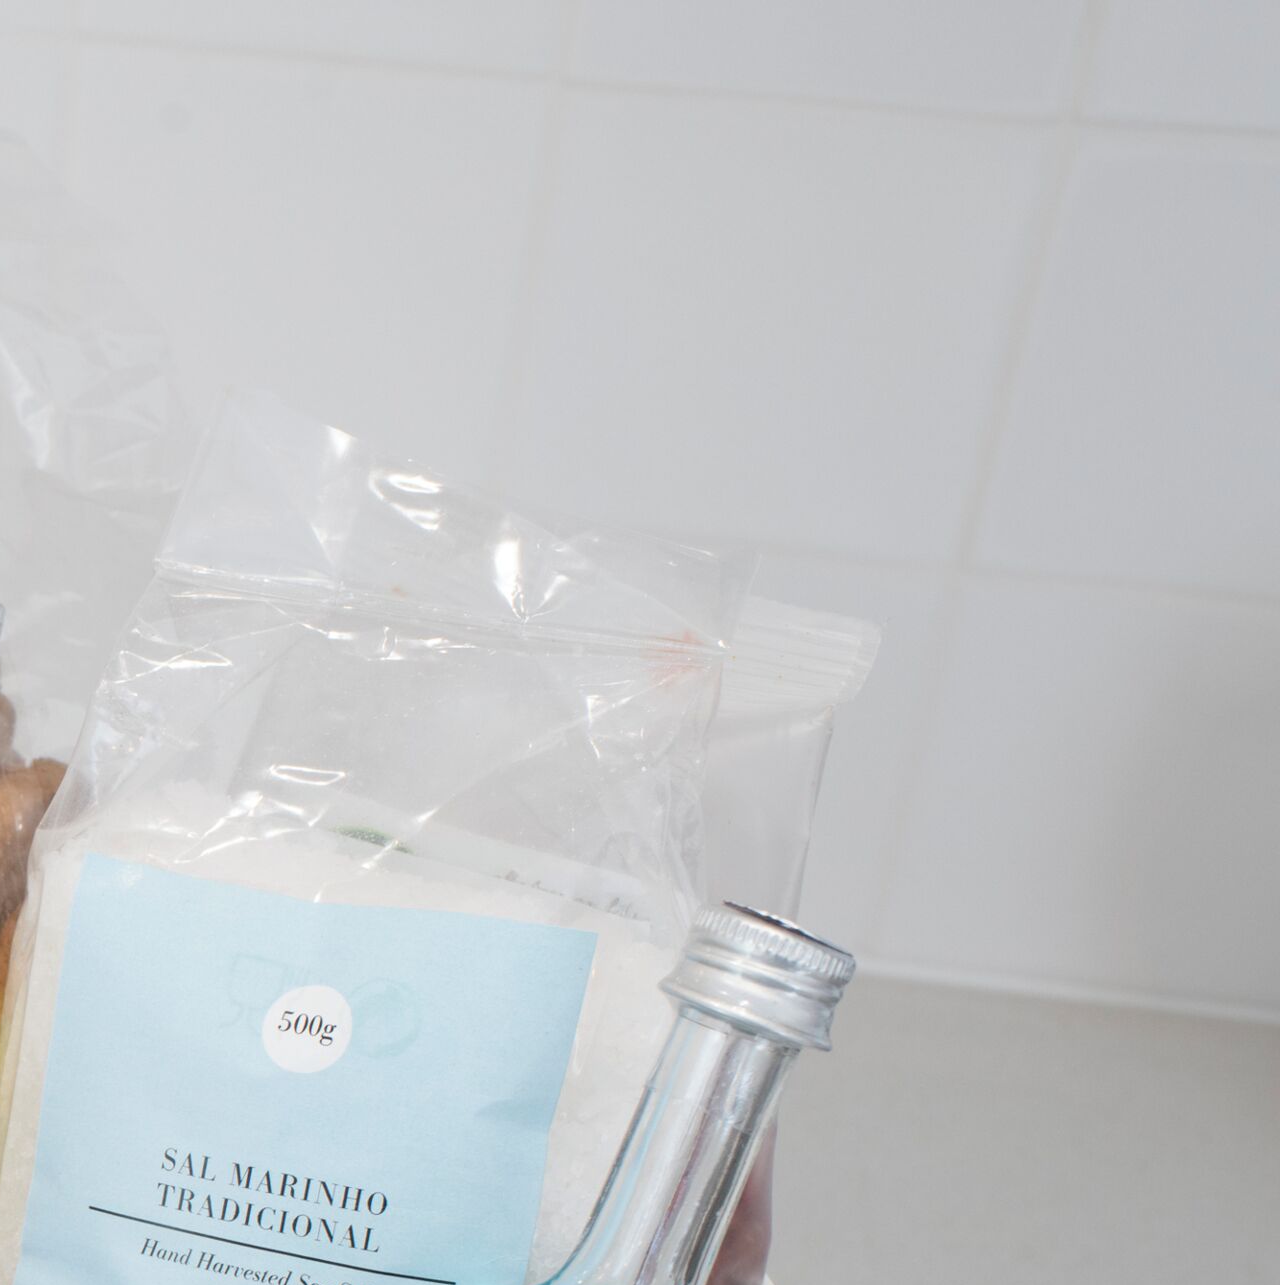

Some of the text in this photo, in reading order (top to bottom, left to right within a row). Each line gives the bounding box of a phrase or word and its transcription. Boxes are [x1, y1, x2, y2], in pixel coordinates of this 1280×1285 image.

[277, 1010, 338, 1047] 500g
[160, 1147, 389, 1217] SAL MARINHO
[156, 1182, 381, 1254] TRADICIONAL
[140, 1237, 193, 1266] Hand
